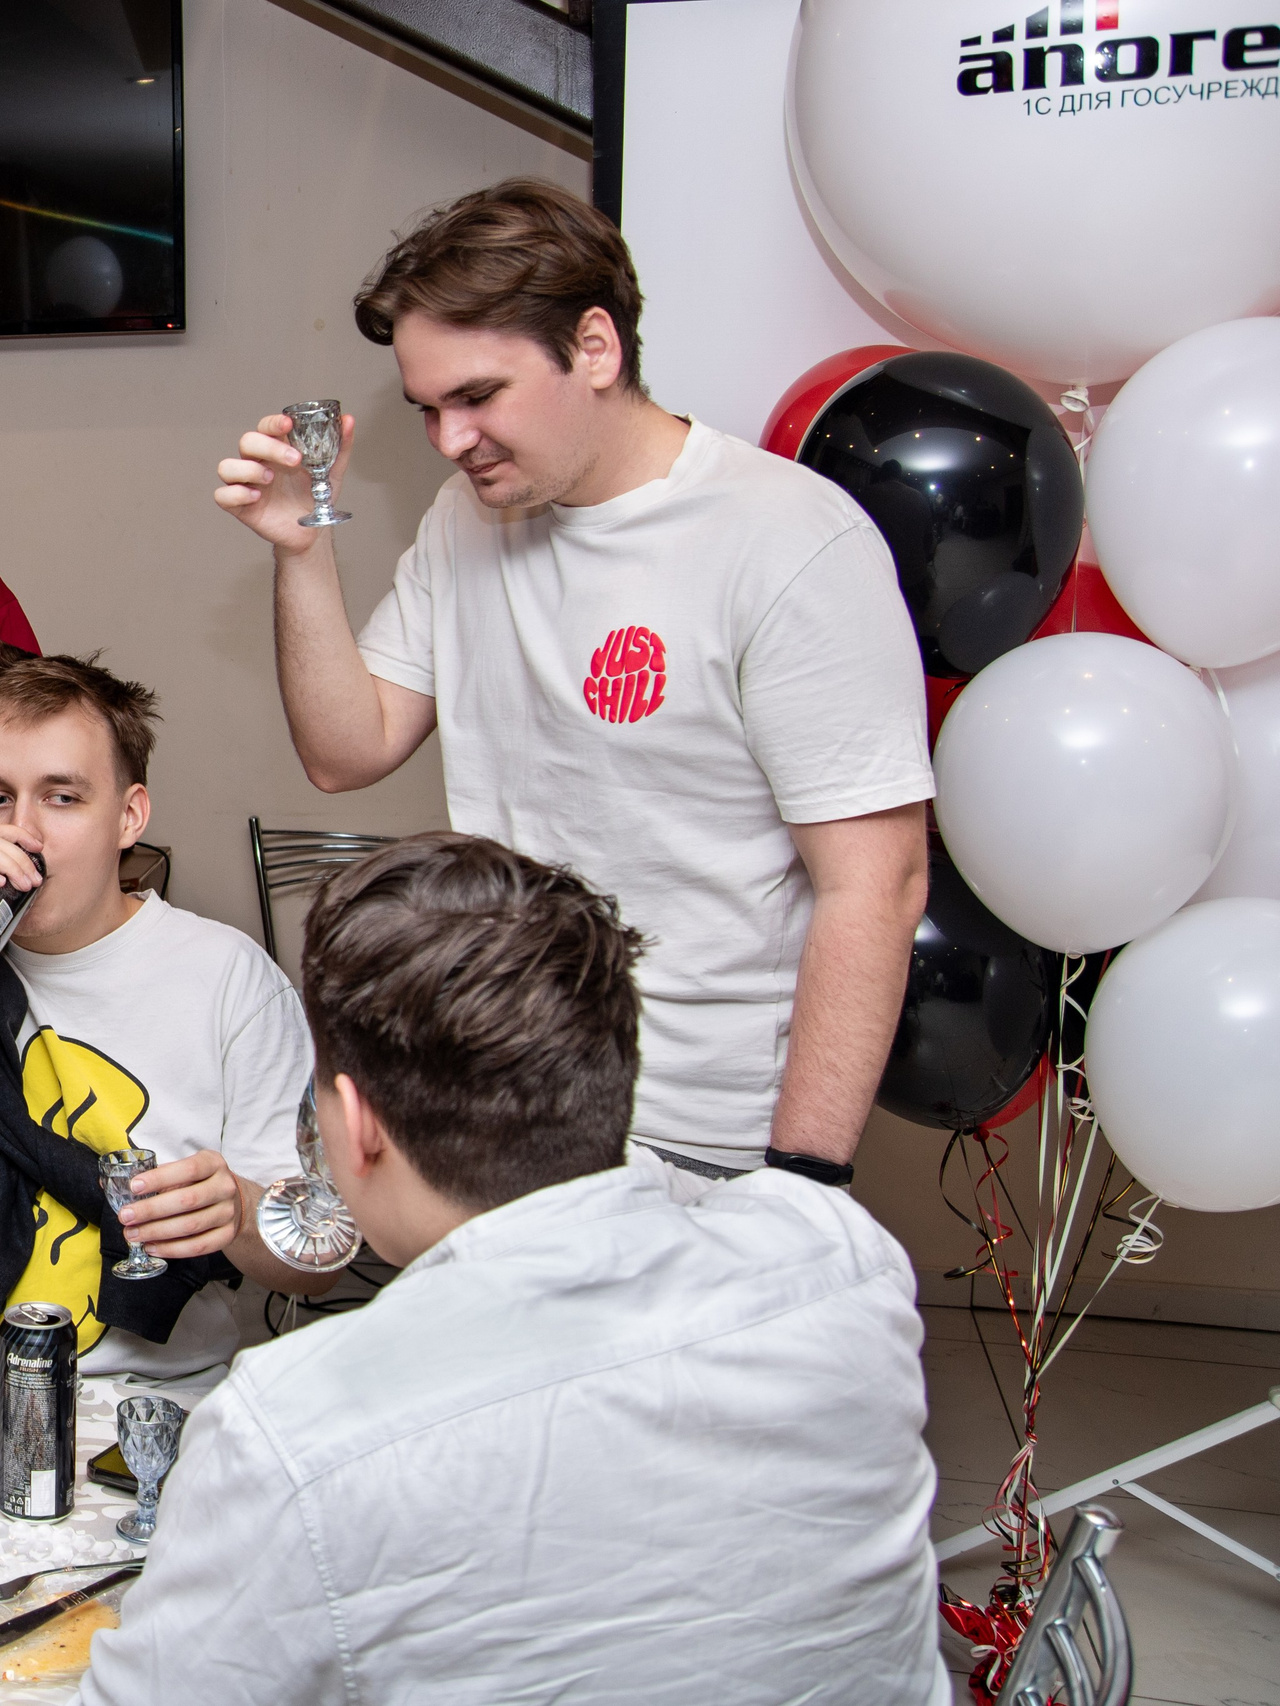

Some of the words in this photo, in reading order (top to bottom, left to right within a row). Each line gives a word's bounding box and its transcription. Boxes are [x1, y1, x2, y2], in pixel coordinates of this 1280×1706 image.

[1058, 90, 1111, 117] ДЛЯ
[1121, 76, 1280, 108] ГОСУЧРЕЖД
[590, 625, 667, 679] JUST
[583, 669, 667, 724] CHILL
[6, 1352, 54, 1368] Adrenaline
